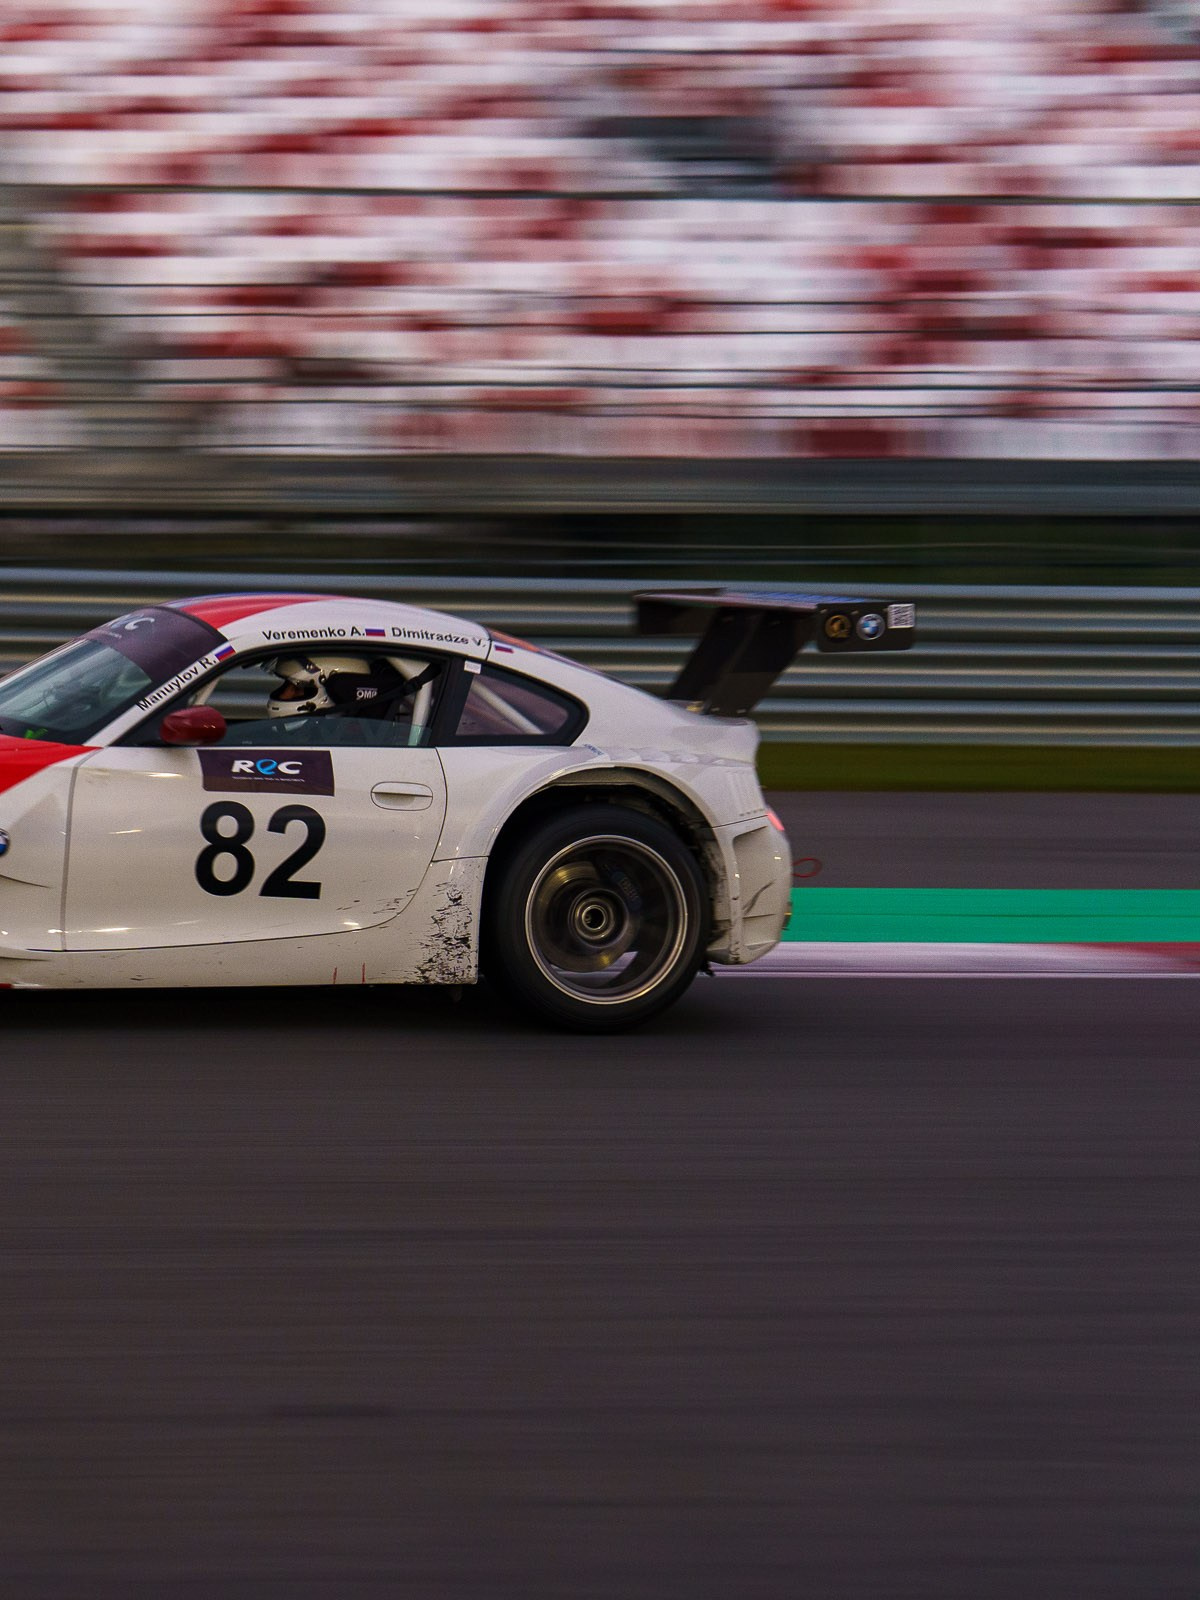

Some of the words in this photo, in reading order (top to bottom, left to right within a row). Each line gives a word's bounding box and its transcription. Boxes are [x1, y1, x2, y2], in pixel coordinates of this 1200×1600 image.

[262, 627, 346, 640] Veremenko
[350, 626, 365, 637] A.
[391, 627, 469, 645] Dimitradze
[136, 666, 199, 711] Manuylov
[199, 657, 217, 671] R.
[195, 800, 326, 899] 82
